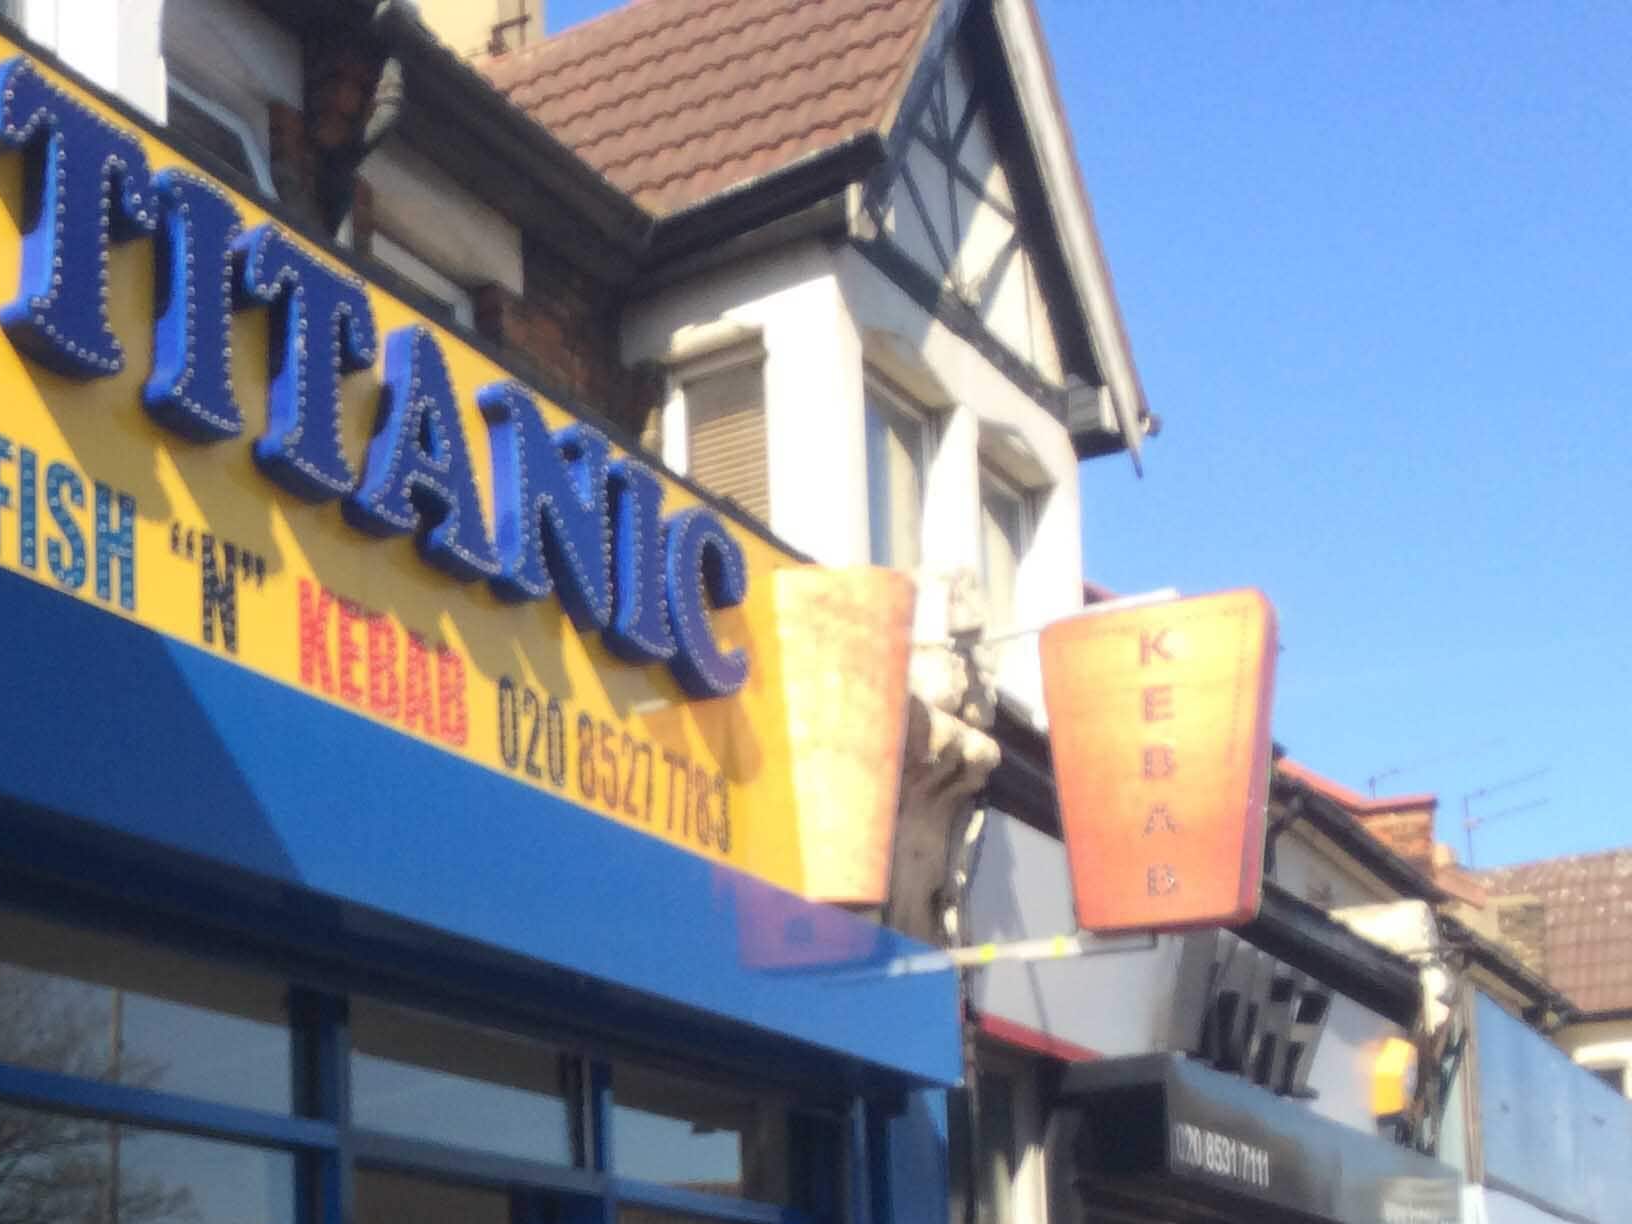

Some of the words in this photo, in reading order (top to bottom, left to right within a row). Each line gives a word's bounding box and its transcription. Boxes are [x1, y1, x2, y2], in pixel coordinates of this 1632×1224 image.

[297, 577, 468, 749] KEBAB
[498, 674, 565, 787] 020
[577, 711, 654, 823] 8527
[1136, 626, 1181, 897] KEBAB
